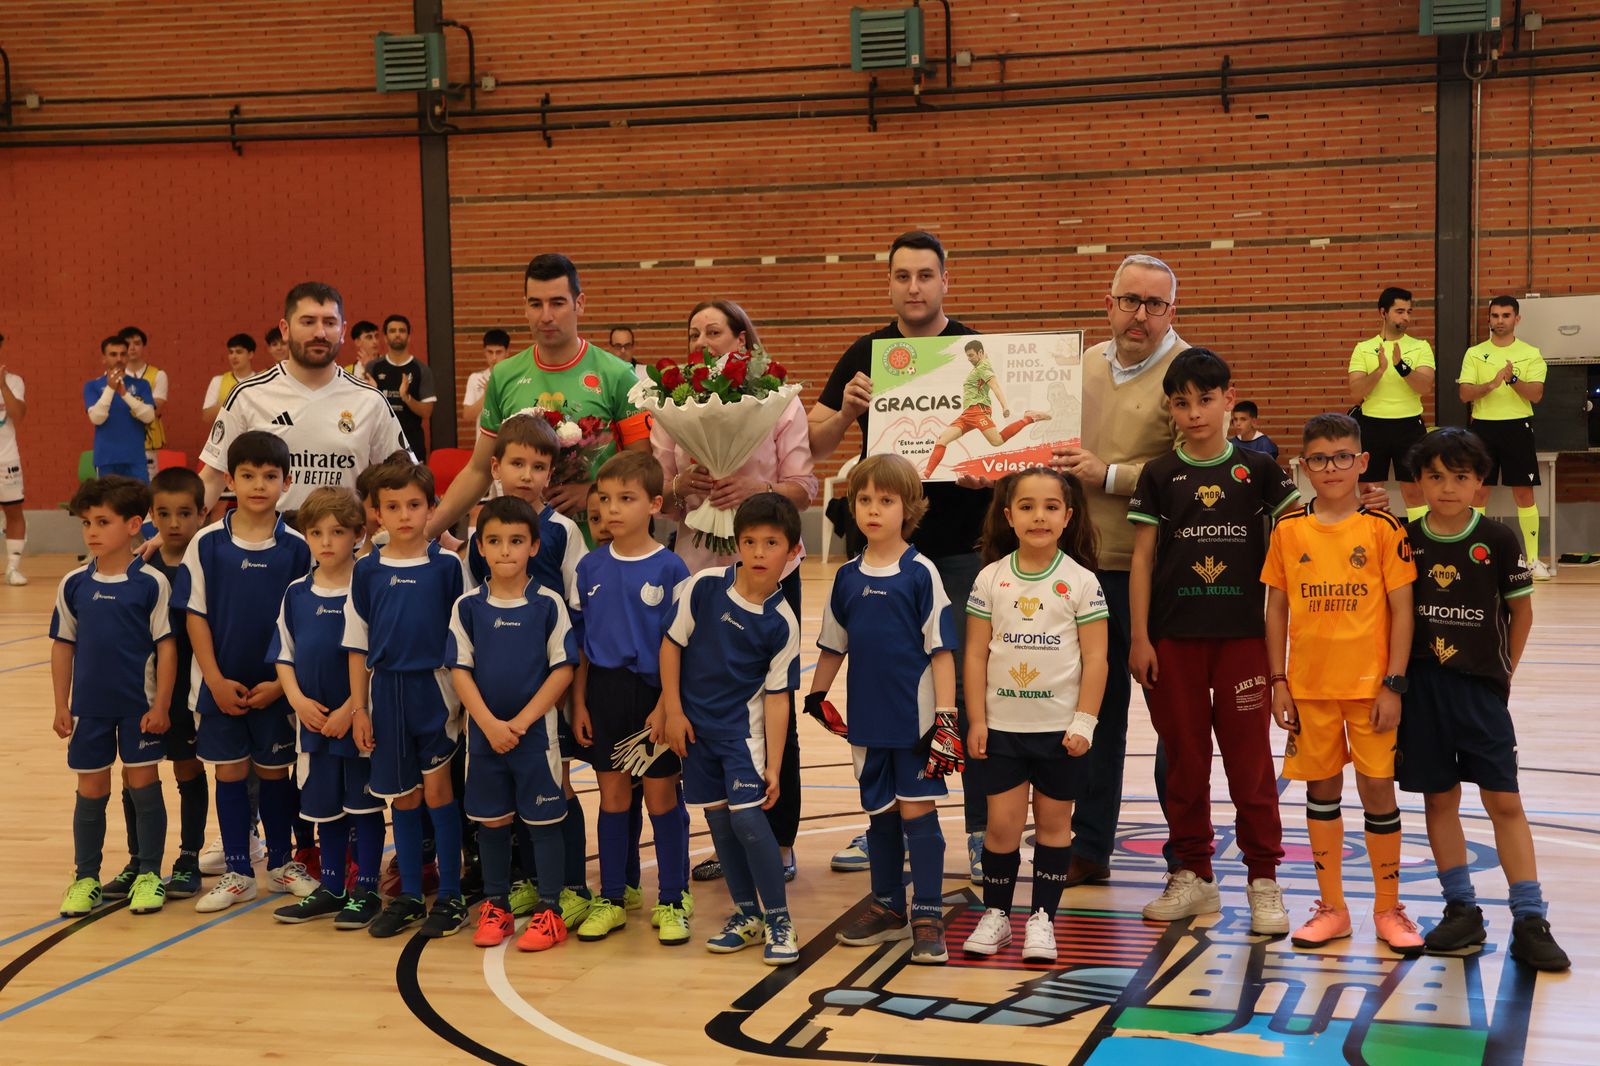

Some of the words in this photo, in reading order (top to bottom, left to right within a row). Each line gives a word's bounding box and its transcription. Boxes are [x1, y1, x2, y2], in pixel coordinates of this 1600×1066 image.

[1008, 343, 1037, 354] BAR
[1007, 359, 1044, 368] HNOS.
[1006, 367, 1072, 383] PINZÓN
[874, 394, 962, 412] GRACIAS
[290, 450, 356, 468] mirates
[304, 470, 342, 485] BETTER
[1194, 490, 1226, 500] ZAMORA
[1182, 522, 1248, 538] euronics
[1428, 569, 1461, 581] ZAMORA
[1178, 586, 1203, 596] CAJA
[1206, 586, 1244, 596] RURAL
[1300, 581, 1368, 598] Emirates
[1308, 600, 1322, 612] FLY
[1324, 598, 1358, 612] BETTER
[1418, 605, 1484, 621] euronics
[1003, 632, 1062, 646] euronics
[1234, 678, 1254, 694] LAKE
[1018, 690, 1054, 699] RURAL
[985, 876, 1010, 884] ARIS
[1037, 870, 1068, 881] PARIS
